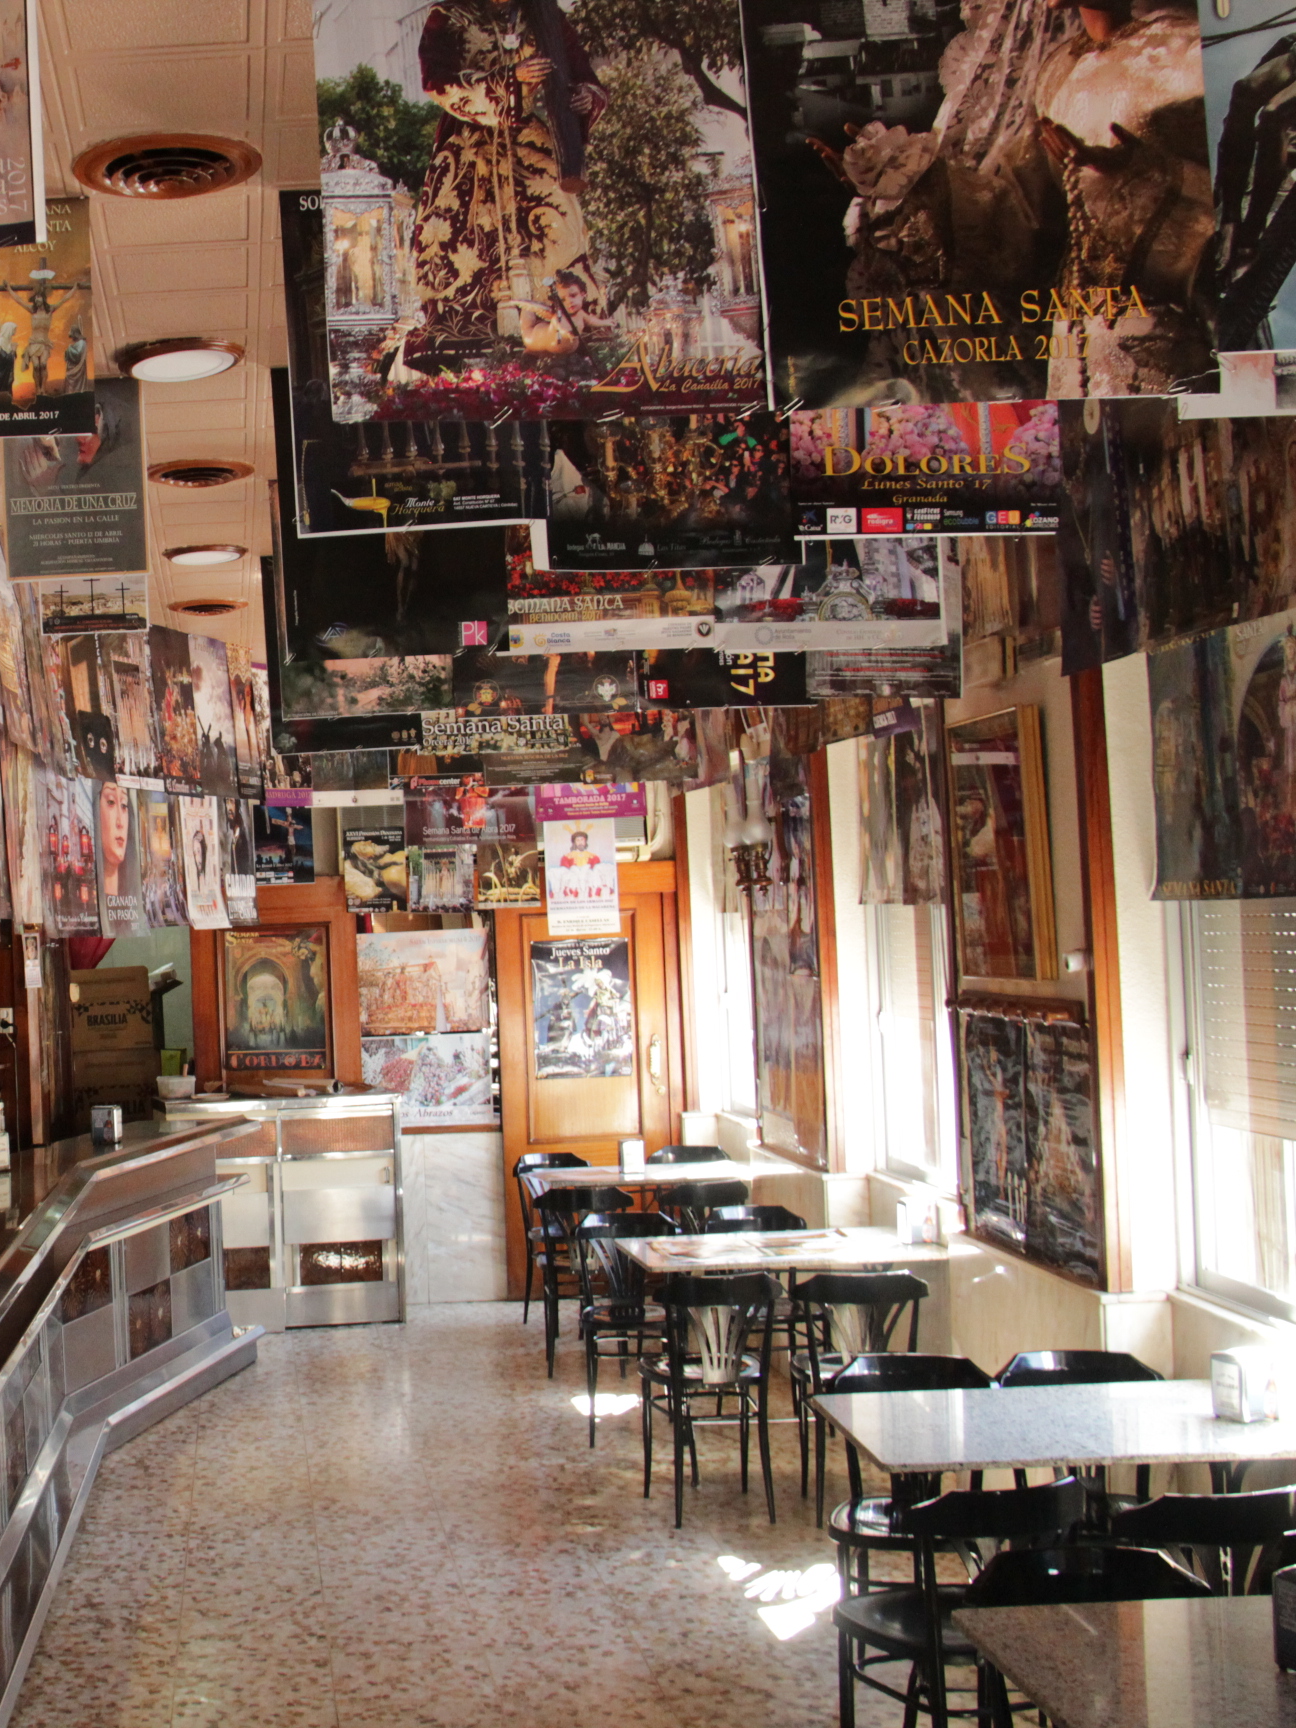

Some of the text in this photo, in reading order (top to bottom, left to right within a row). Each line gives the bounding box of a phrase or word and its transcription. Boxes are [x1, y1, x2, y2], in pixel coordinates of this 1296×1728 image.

[6, 156, 28, 213] 2017
[13, 240, 56, 253] ALCOY
[838, 284, 1151, 332] SEMANA SANTA
[903, 333, 1092, 366] CAZORLA 2017
[590, 333, 765, 393] Abacería
[659, 377, 761, 393] La Cañailla 2017
[0, 413, 11, 421] DE
[12, 412, 38, 420] ABRIL
[39, 411, 60, 420] 2017
[861, 478, 965, 491] Lunes Santo
[10, 495, 138, 514] MEMORIA DE UNA CRUZ
[405, 497, 435, 508] Monte
[892, 493, 948, 506] Granada
[391, 503, 445, 518] Horquera
[44, 517, 71, 525] PASION
[985, 511, 1020, 525] GEU
[507, 595, 624, 615] SEMANA SANTA
[529, 610, 600, 624] BENIDORM 2017
[774, 627, 812, 636] Ayuntamiento
[422, 714, 564, 736] Semana Santa
[422, 736, 474, 747] Orcera 2017
[554, 794, 626, 805] TAMBORADA 2017
[423, 824, 516, 836] Semana Santa de 2017
[1204, 879, 1236, 895] SANTA
[107, 895, 138, 907] GRANADA
[108, 910, 117, 920] EN
[117, 907, 139, 920] PASIÓN
[550, 945, 610, 959] Jueves Santo
[559, 955, 603, 970] La Isla
[87, 1013, 128, 1027] BRASILIA
[415, 1107, 454, 1119] Abrazos
